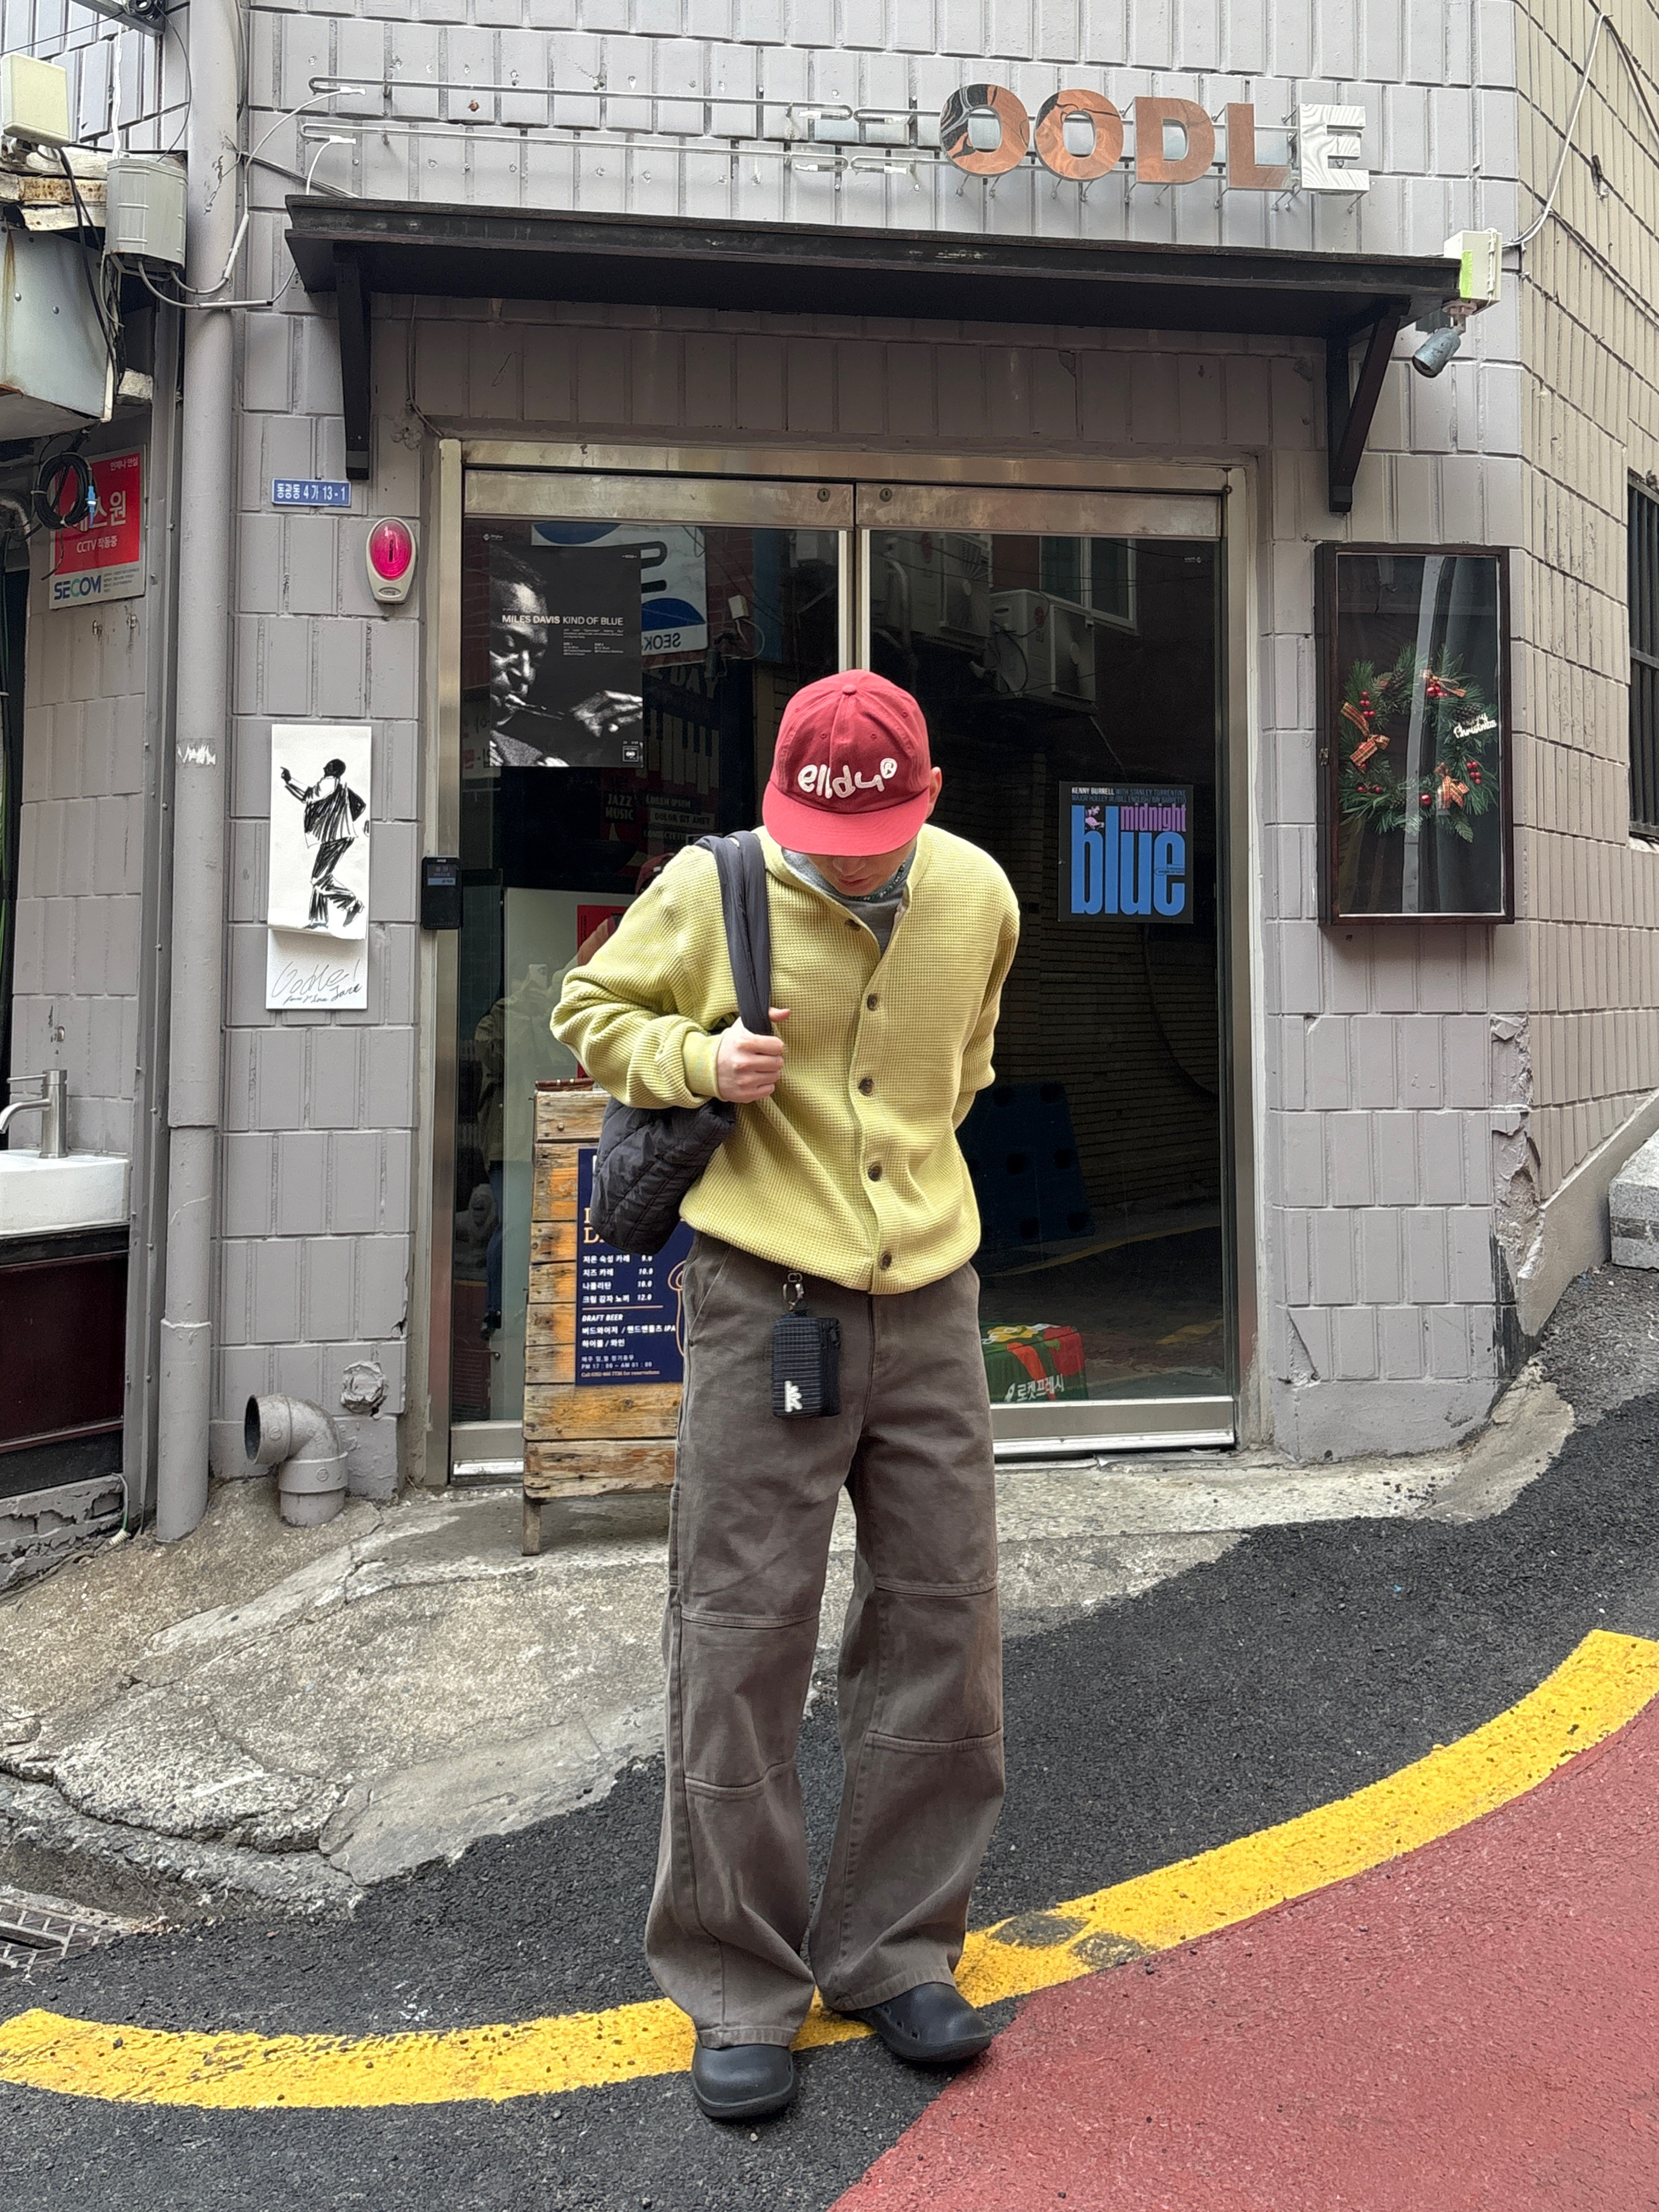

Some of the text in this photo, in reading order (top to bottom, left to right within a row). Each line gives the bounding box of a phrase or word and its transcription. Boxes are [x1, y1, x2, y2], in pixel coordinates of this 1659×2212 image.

[71, 490, 126, 532] 스원
[77, 539, 97, 553] CCTV
[54, 575, 102, 601] SECOM
[502, 615, 624, 626] MILES DAVIS KIND OF BLUE
[607, 793, 632, 807] JAZZ
[605, 807, 634, 820] MUSIC
[1120, 802, 1187, 832] midnight
[1071, 805, 1185, 916] blue
[615, 1254, 630, 1263] 카레
[598, 1268, 614, 1276] 카레
[582, 1326, 618, 1335] 버드와이저
[610, 1338, 625, 1347] 와인
[1017, 1373, 1065, 1402] 로켓프레시
